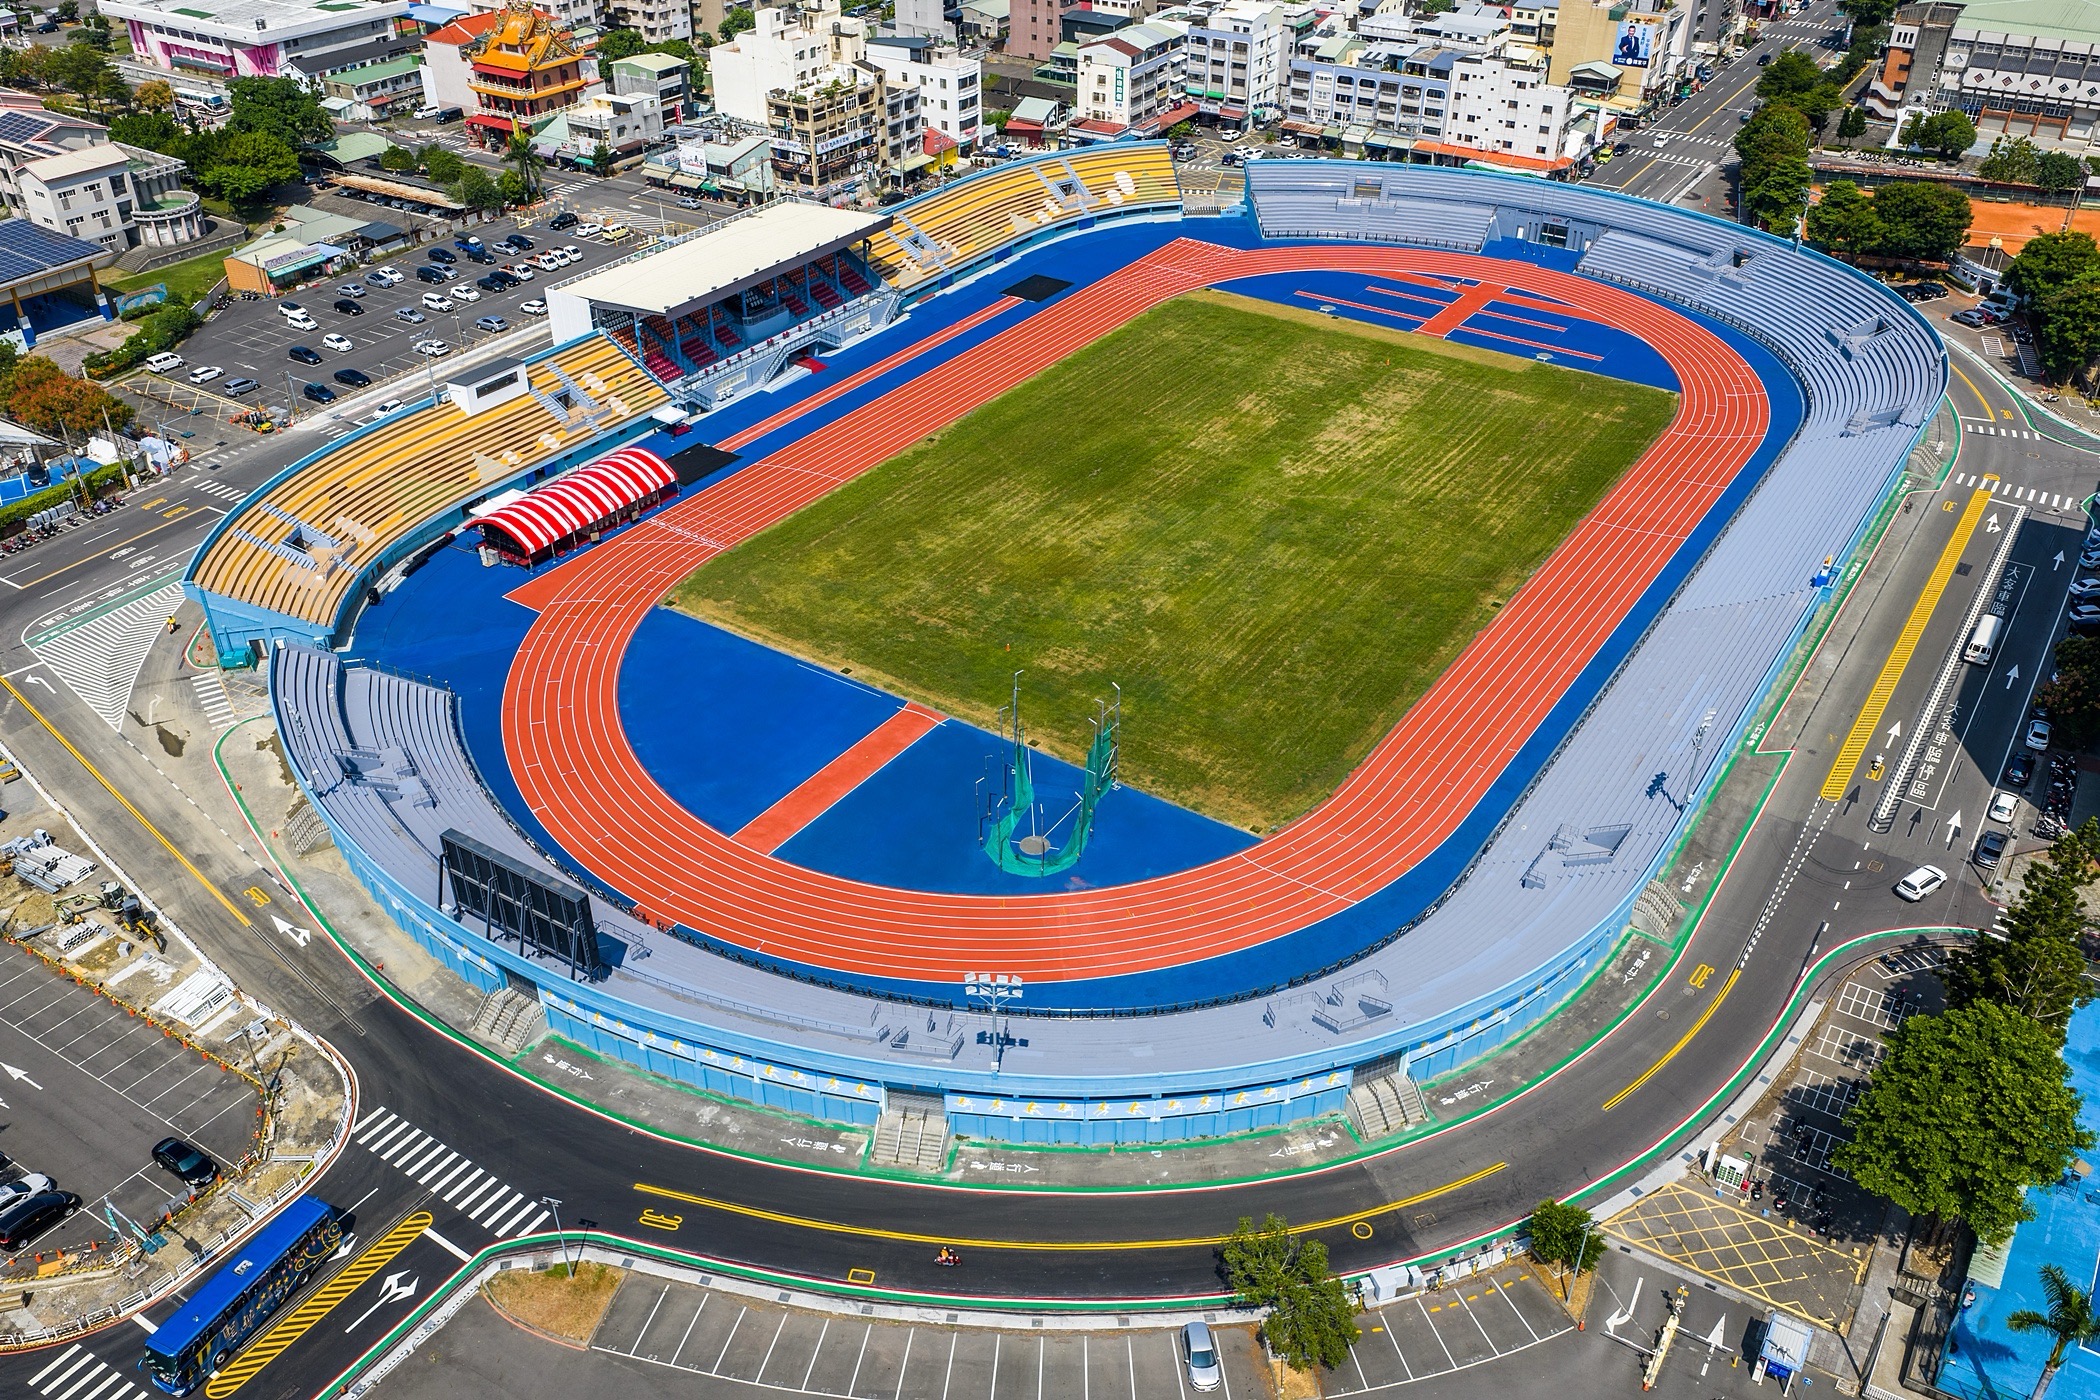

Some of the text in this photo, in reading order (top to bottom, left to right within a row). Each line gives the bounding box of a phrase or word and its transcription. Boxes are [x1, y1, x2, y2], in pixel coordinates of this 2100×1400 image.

[1942, 500, 1957, 513] 30
[1910, 700, 1962, 799] 大客車臨停區
[243, 886, 272, 908] 30
[1688, 963, 1715, 989] 30
[638, 1208, 683, 1231] 30
